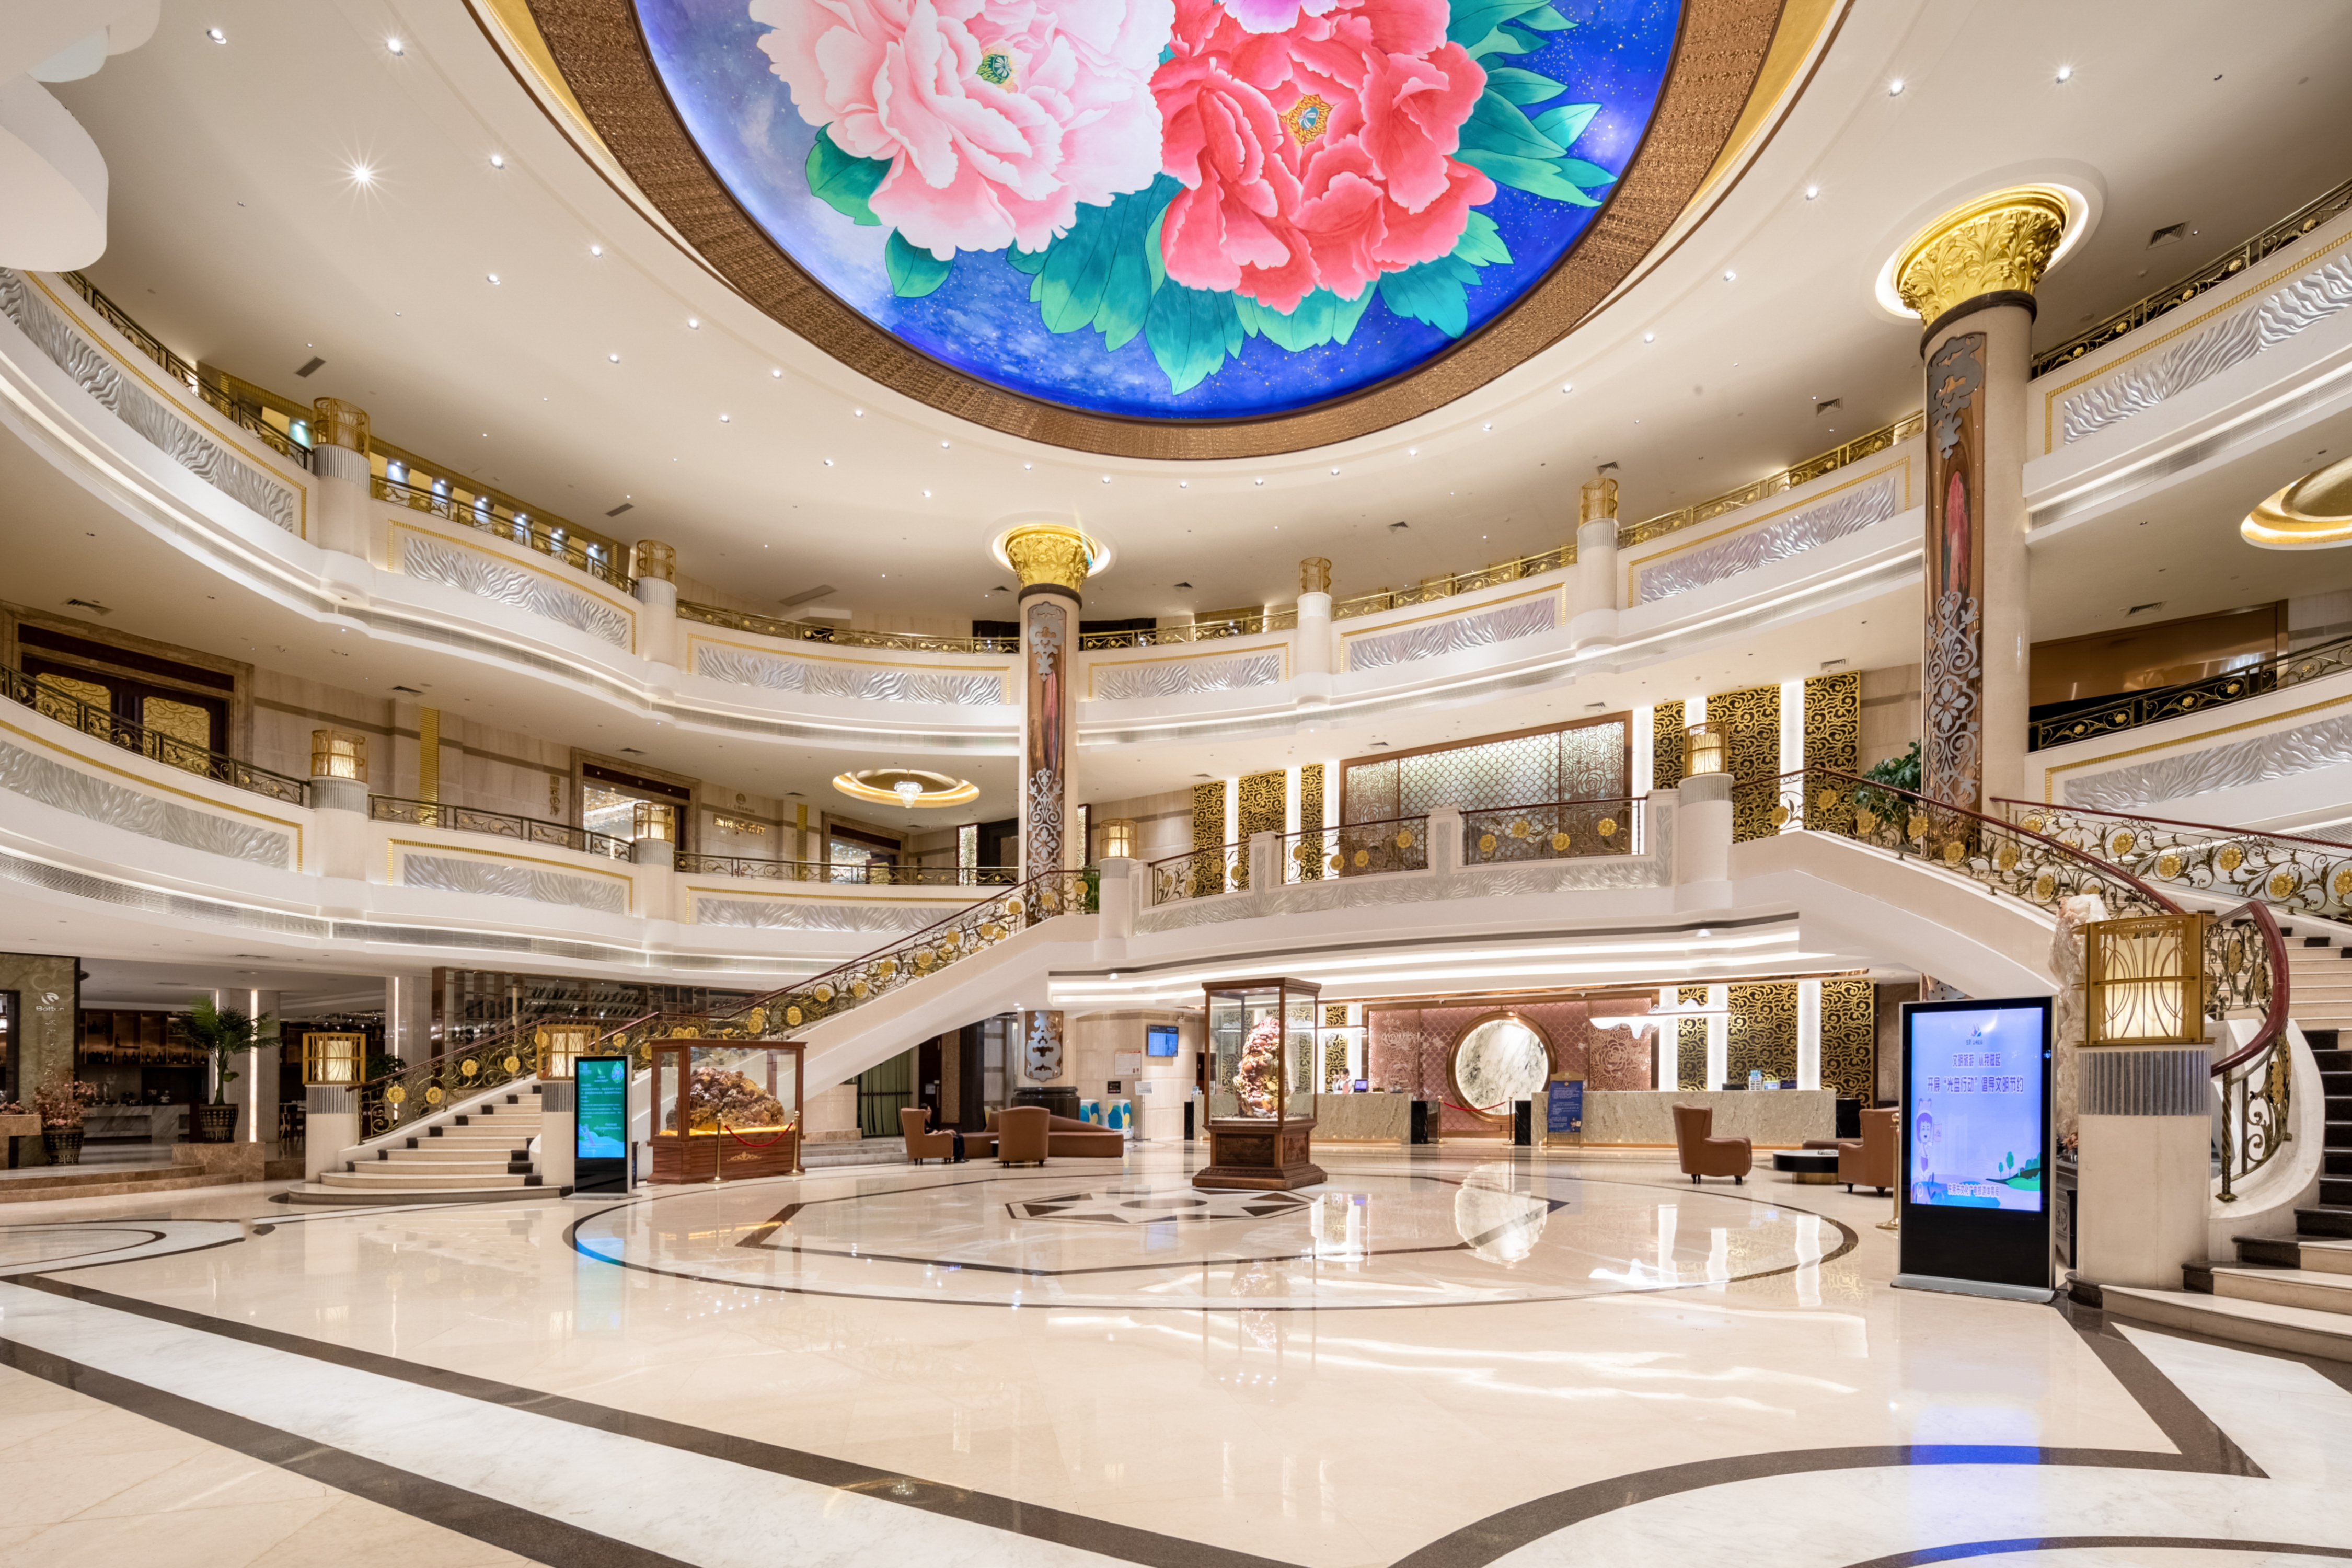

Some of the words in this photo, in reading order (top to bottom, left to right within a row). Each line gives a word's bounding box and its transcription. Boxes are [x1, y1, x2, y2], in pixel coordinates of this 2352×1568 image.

[1953, 1053, 1974, 1067] 文明旅游
[1979, 1053, 2001, 1067] 从我做起
